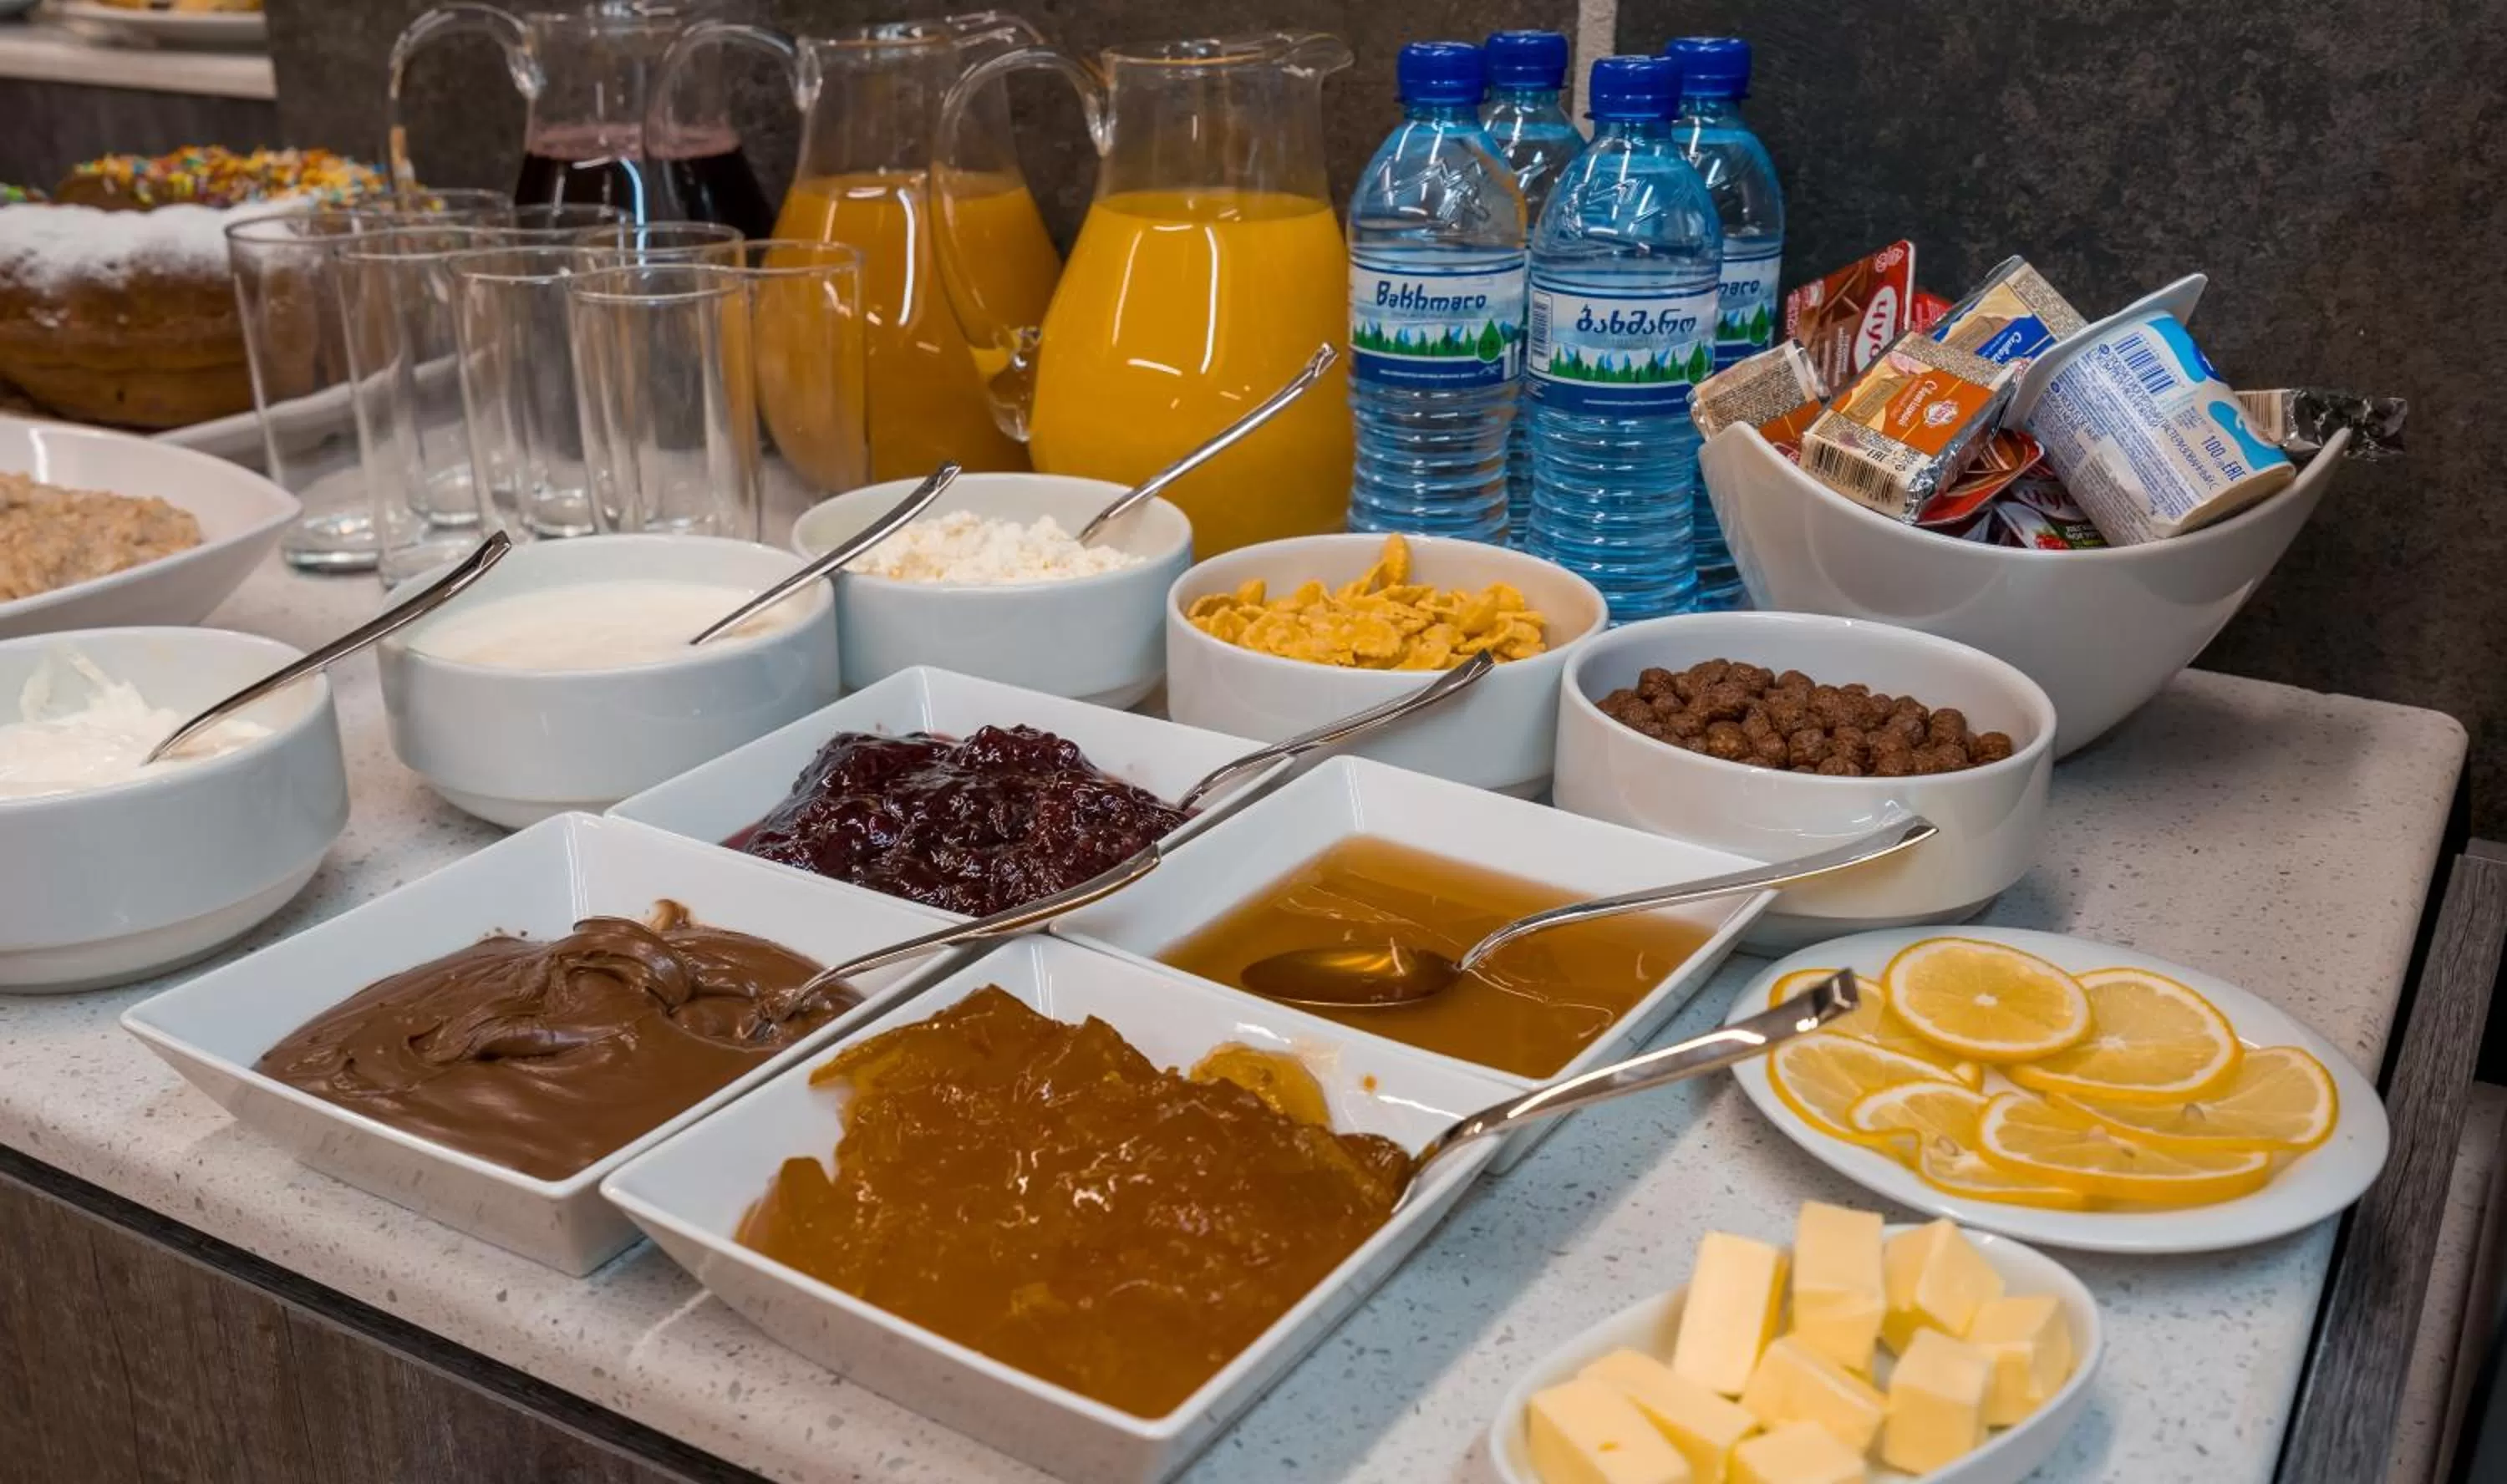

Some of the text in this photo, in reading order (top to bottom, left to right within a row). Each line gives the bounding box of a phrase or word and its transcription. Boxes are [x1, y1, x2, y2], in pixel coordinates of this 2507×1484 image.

[1376, 280, 1487, 312] Bakhmaro
[1716, 278, 1761, 296] maro
[1575, 303, 1697, 335] ბახმარო
[2199, 434, 2226, 456] 100
